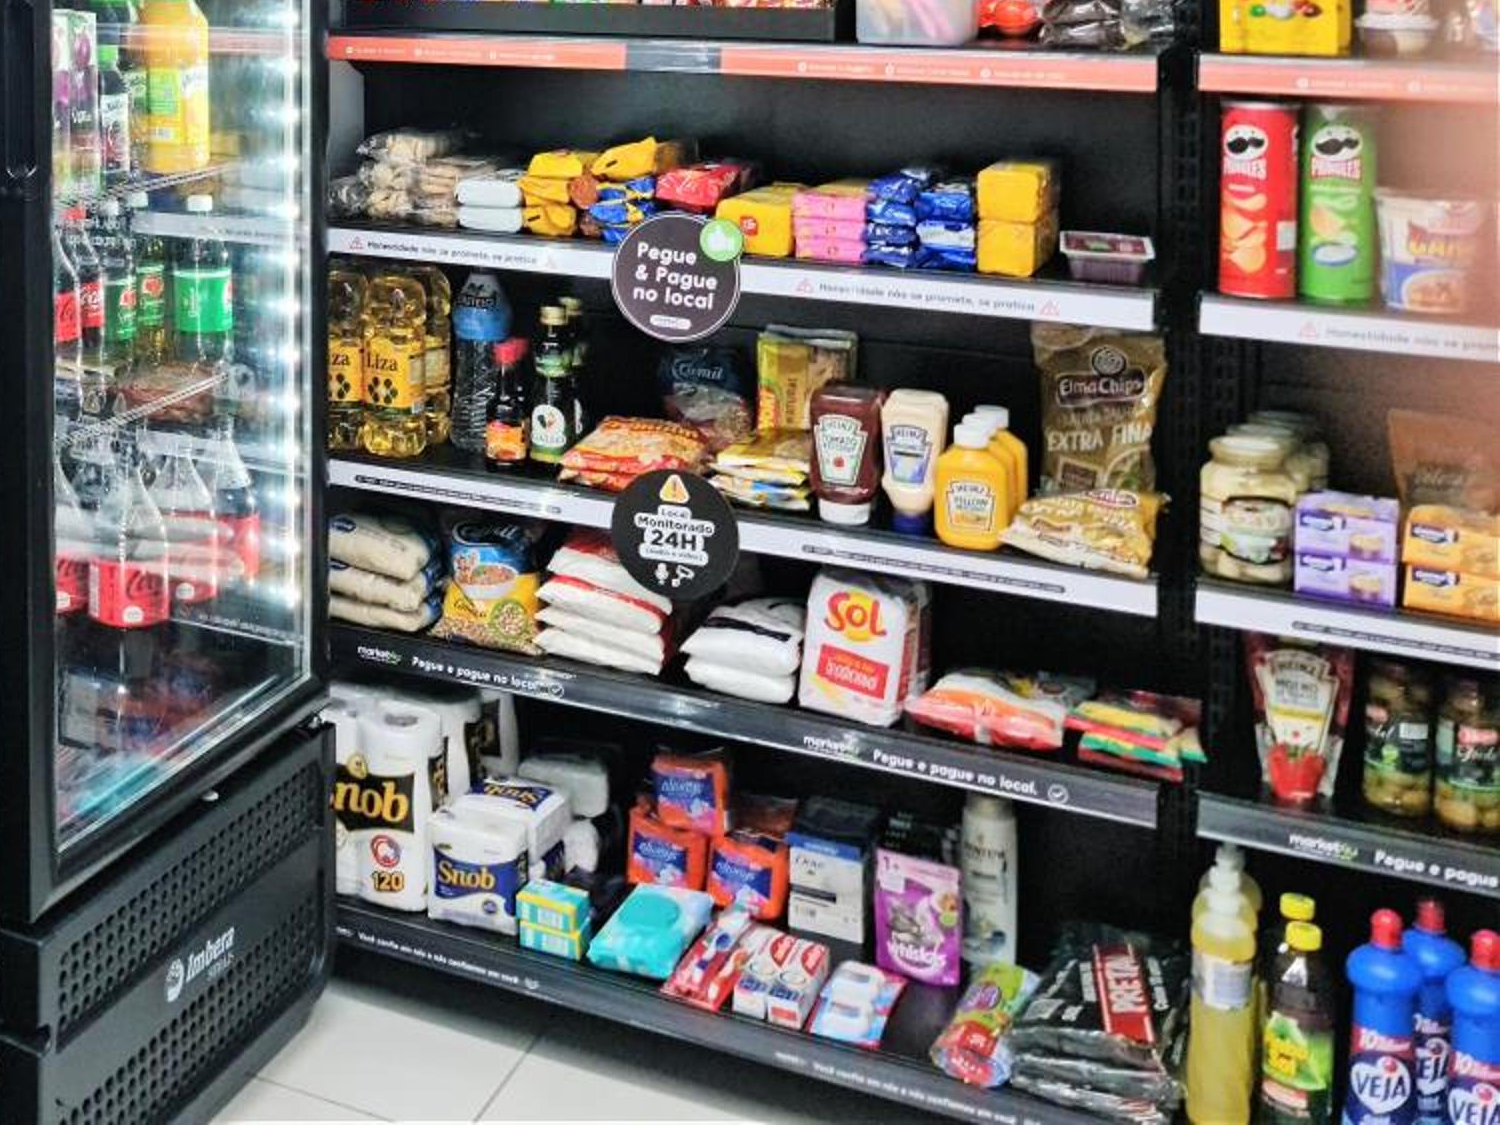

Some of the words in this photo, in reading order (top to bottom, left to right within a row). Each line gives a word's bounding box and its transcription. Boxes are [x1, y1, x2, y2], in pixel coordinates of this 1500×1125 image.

[637, 241, 698, 267] Pegue
[634, 264, 649, 280] &
[655, 266, 718, 294] Pague
[632, 285, 658, 304] no
[664, 285, 714, 310] local
[1046, 430, 1102, 453] EXTRA
[637, 515, 714, 536] Monitorado
[649, 530, 698, 551] 24H
[411, 655, 444, 677] Pegue
[456, 664, 493, 684] pague
[493, 673, 510, 686] no
[873, 750, 915, 774] Pegue
[916, 759, 928, 771] e
[930, 760, 976, 783] pague
[977, 772, 997, 787] no
[999, 775, 1039, 797] local.
[371, 870, 405, 893] 120
[437, 859, 497, 893] Snob
[1374, 849, 1425, 874] Pegue
[1429, 864, 1441, 877] e
[1444, 865, 1499, 889] pague
[186, 926, 236, 984] Imbera
[1355, 1071, 1408, 1093] VEJA
